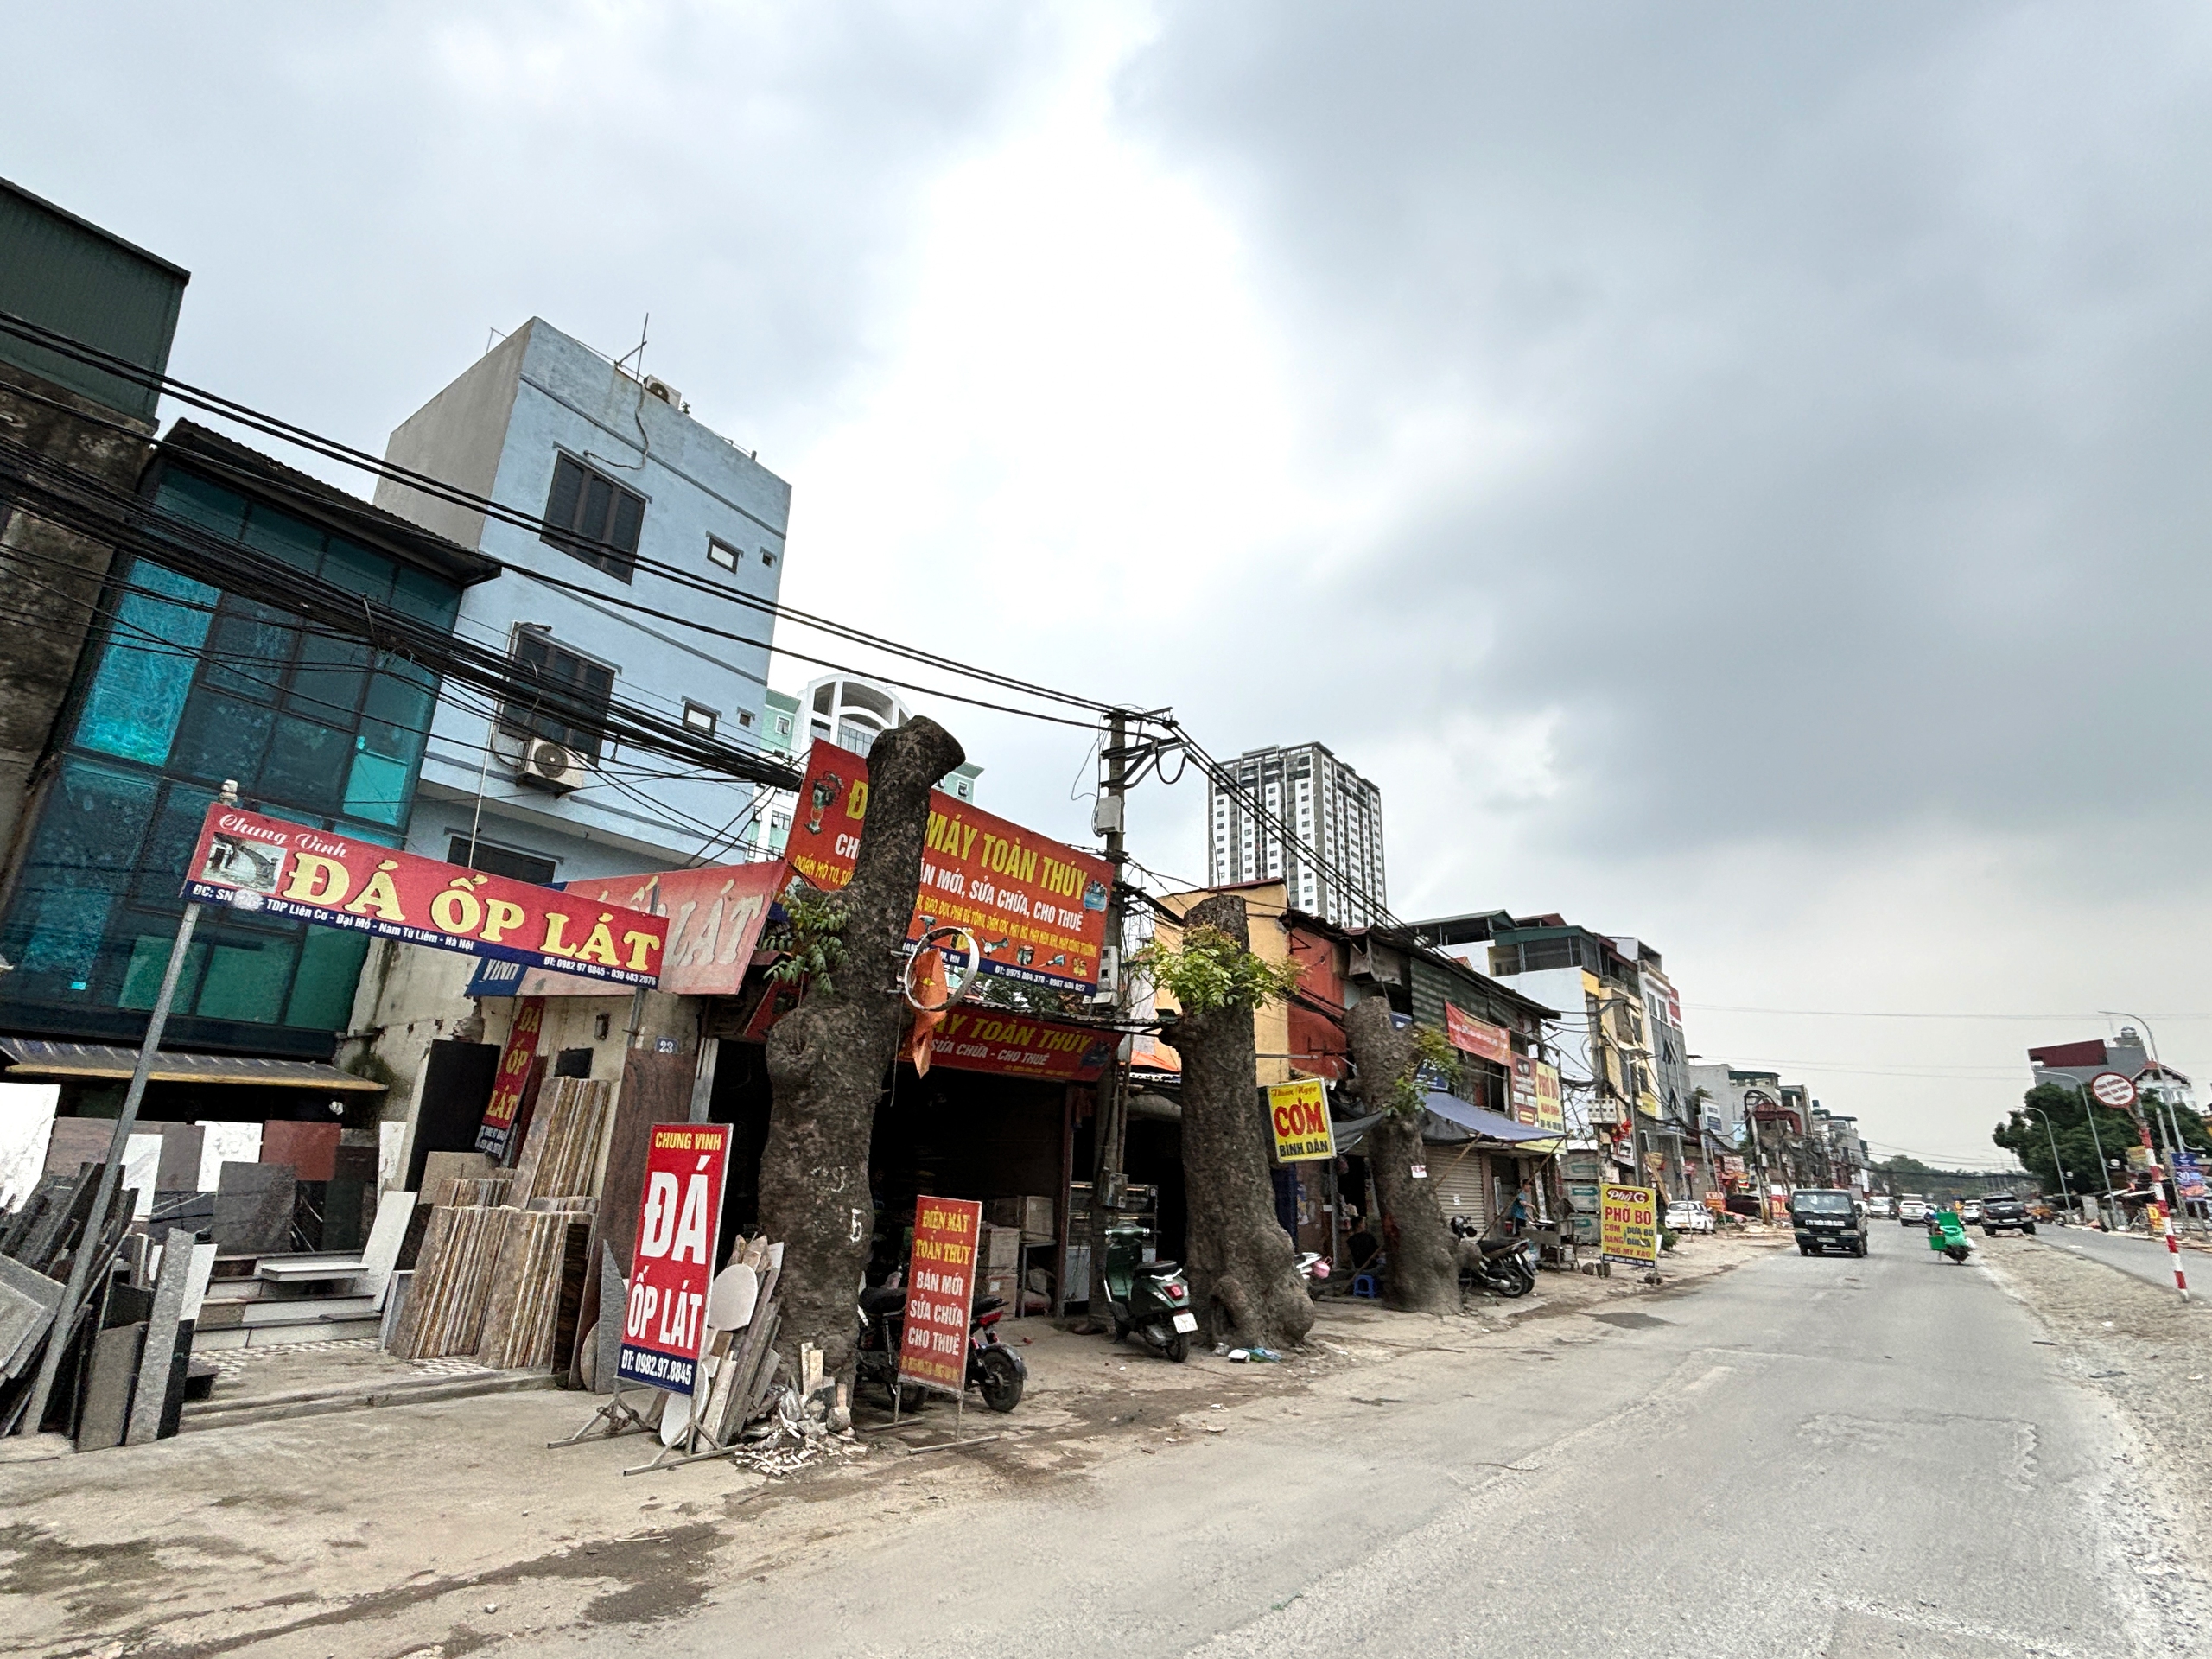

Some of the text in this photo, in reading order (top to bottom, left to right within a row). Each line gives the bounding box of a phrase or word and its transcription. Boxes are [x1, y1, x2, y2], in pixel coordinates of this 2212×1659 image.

[219, 814, 346, 858] Chung Vinh
[925, 810, 978, 861] MÁY
[980, 832, 1038, 884] TOÀN
[1039, 855, 1089, 900] THÚY
[282, 852, 660, 971] ĐÁ ỐP LÁT
[936, 868, 965, 899] MỚI,
[969, 875, 995, 906] SỬA
[996, 889, 1030, 918] CHỮA,
[1033, 901, 1056, 924] CHO
[1058, 908, 1084, 932] THUÊ
[216, 887, 234, 902] SN
[266, 899, 288, 912] TDP
[289, 902, 312, 918] Liên
[314, 909, 328, 921] Cơ
[336, 913, 353, 927] Đại
[378, 922, 401, 936] Nam
[403, 926, 415, 939] Từ
[416, 929, 438, 944] Liêm
[445, 936, 457, 948] Hà
[459, 939, 474, 951] Nội
[664, 879, 764, 967] LÁT
[556, 957, 575, 969] 0982
[576, 962, 586, 972] 97
[658, 1040, 673, 1053] 23
[969, 1019, 1037, 1047] TOÀN
[1037, 1028, 1093, 1053] THÚY
[957, 1042, 988, 1058] CHỮA
[997, 1049, 1020, 1063] CHO
[1020, 1052, 1050, 1066] THUÊ
[1274, 1096, 1325, 1138] CƠM
[655, 1132, 722, 1151] CHUNG VINH
[1279, 1139, 1329, 1157] BÌNH DÂN
[639, 1154, 711, 1265] ĐÁ
[946, 1208, 971, 1234] MÁY
[1605, 1204, 1651, 1225] PHỞ BÒ
[916, 1235, 971, 1265] TOÀN THÚY
[917, 1268, 963, 1296] BÁN MỚI
[626, 1265, 702, 1350] ỐP LÁT
[909, 1294, 963, 1328] SỬA CHỮA
[907, 1326, 961, 1356] CHO THUÊ
[635, 1351, 692, 1385] 0982.97.8845
